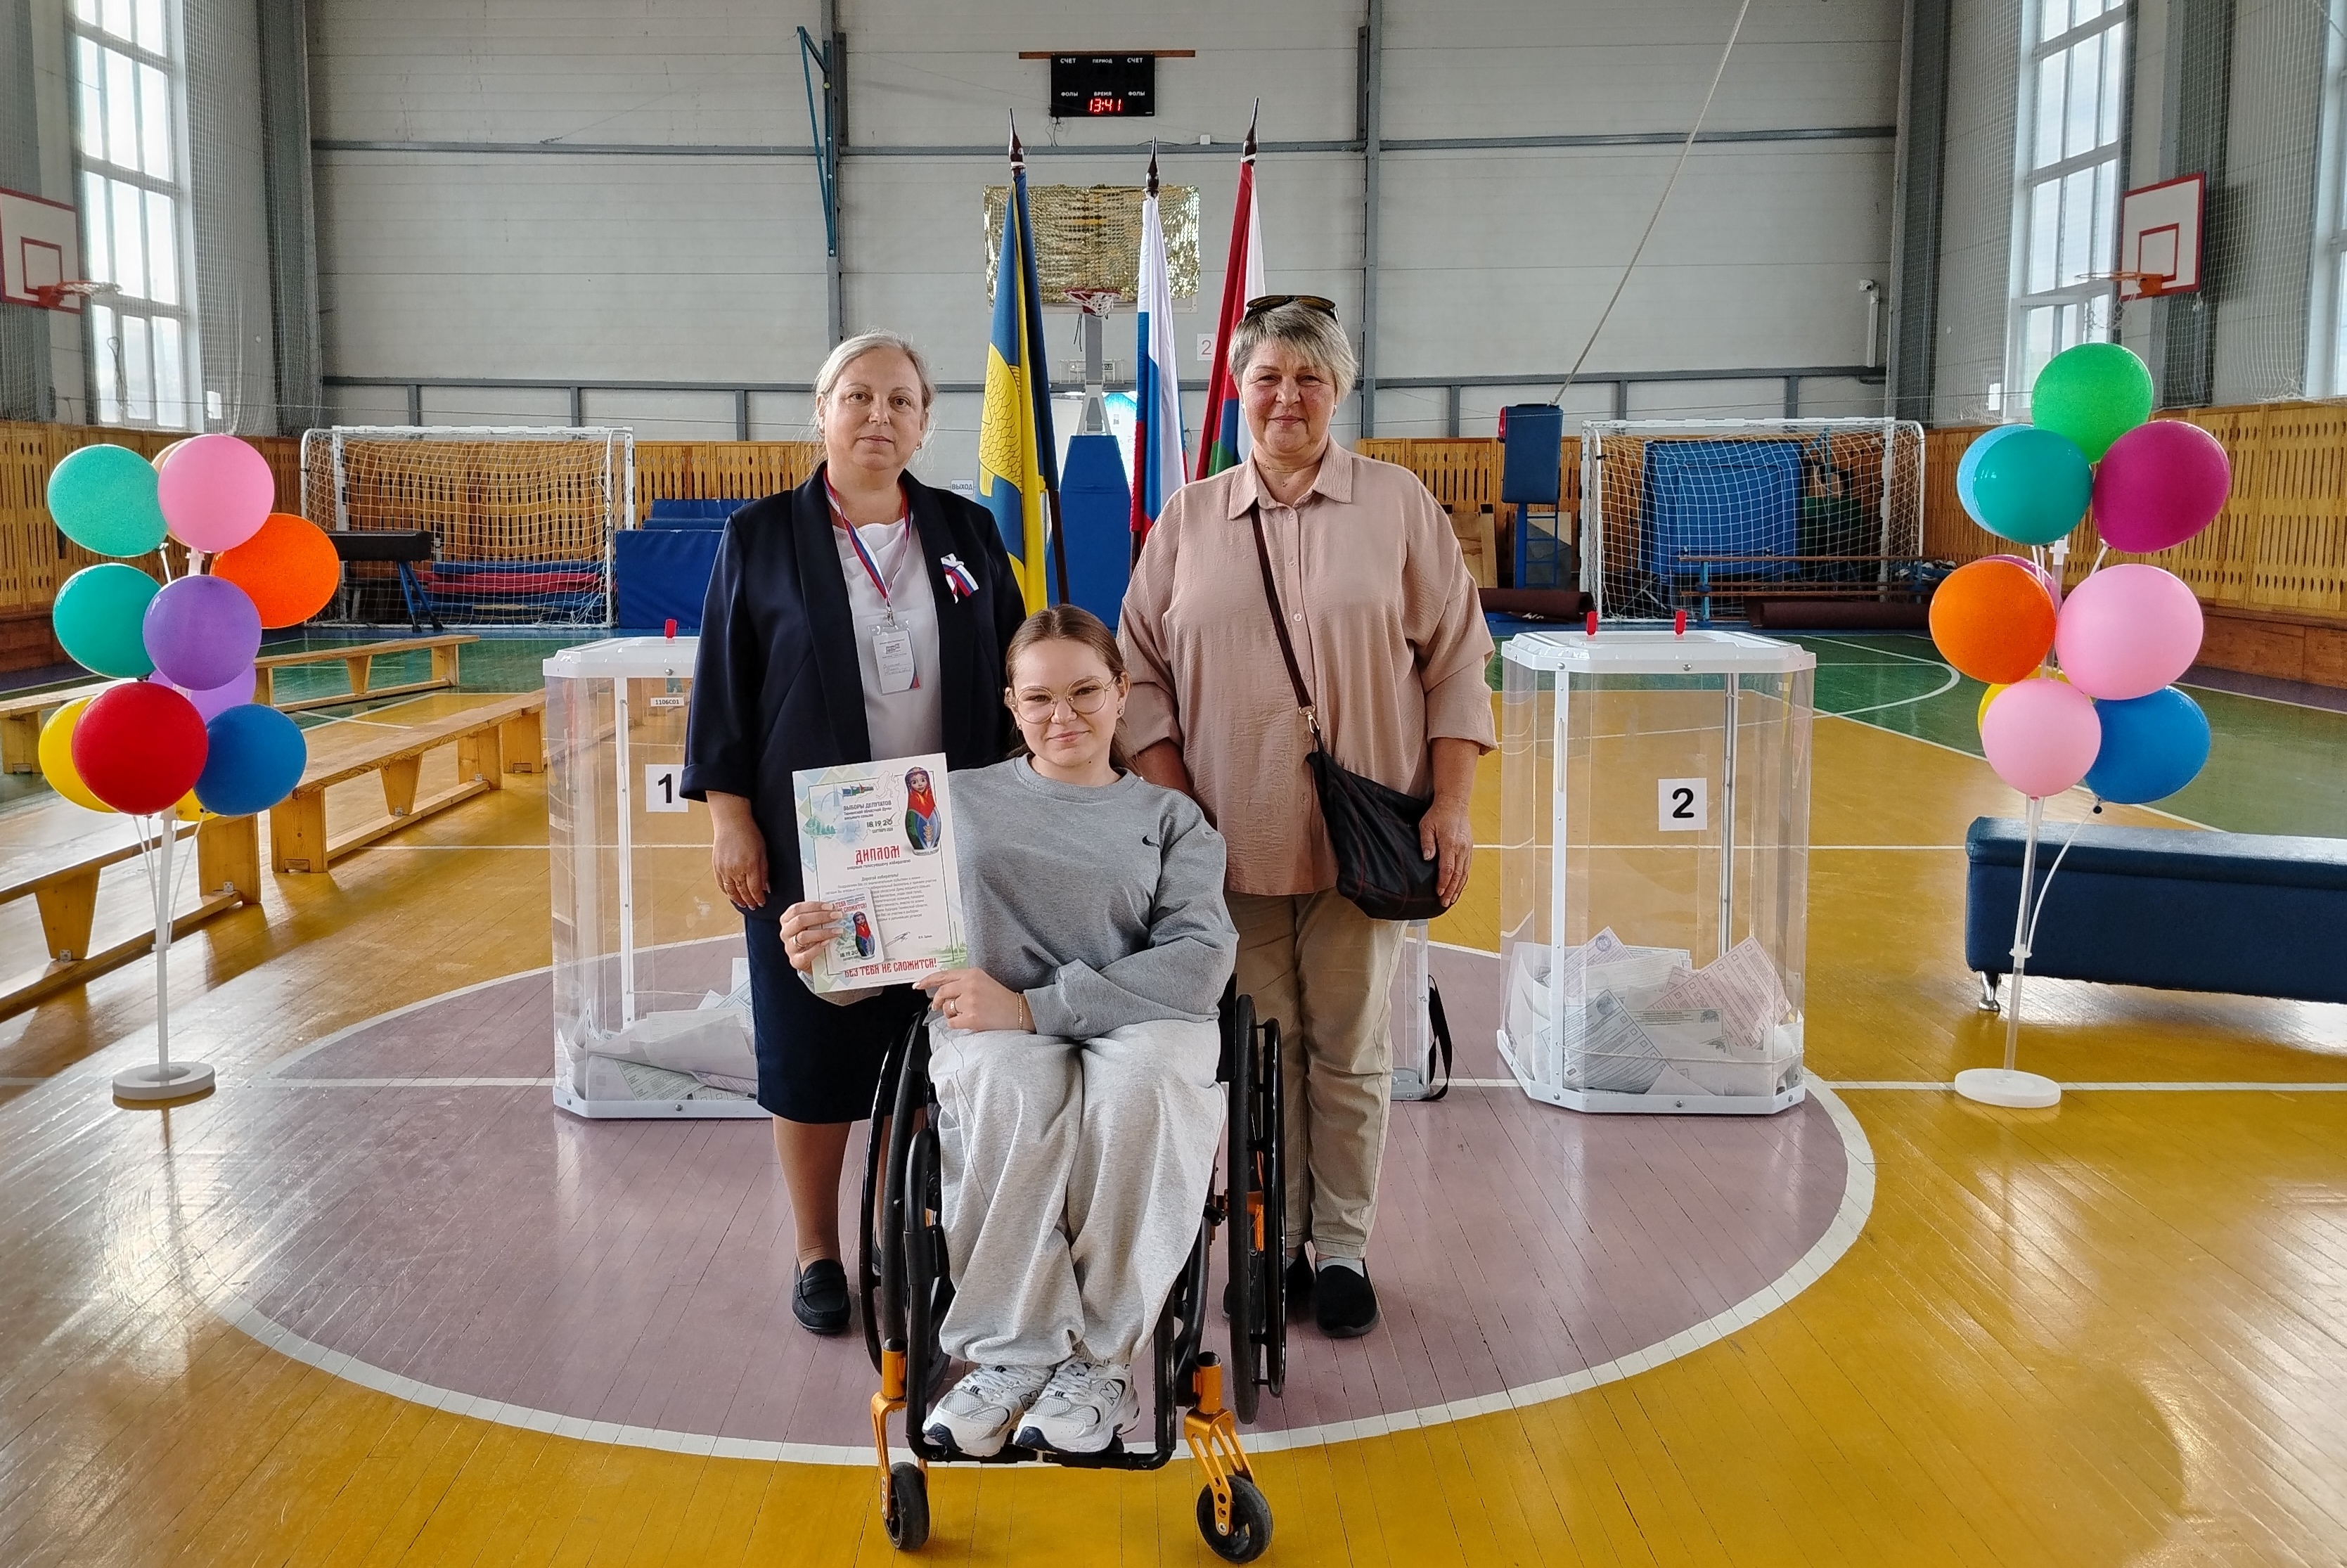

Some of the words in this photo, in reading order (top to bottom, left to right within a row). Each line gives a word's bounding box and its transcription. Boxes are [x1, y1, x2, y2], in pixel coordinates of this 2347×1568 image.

[1089, 98, 1121, 113] 13:41
[1202, 340, 1211, 355] 2
[657, 773, 672, 804] 1
[1672, 788, 1695, 818] 2
[860, 965, 880, 976] ТЕБЯ
[882, 963, 892, 973] НЕ
[894, 958, 937, 972] СЛОЖИТСЯ!
